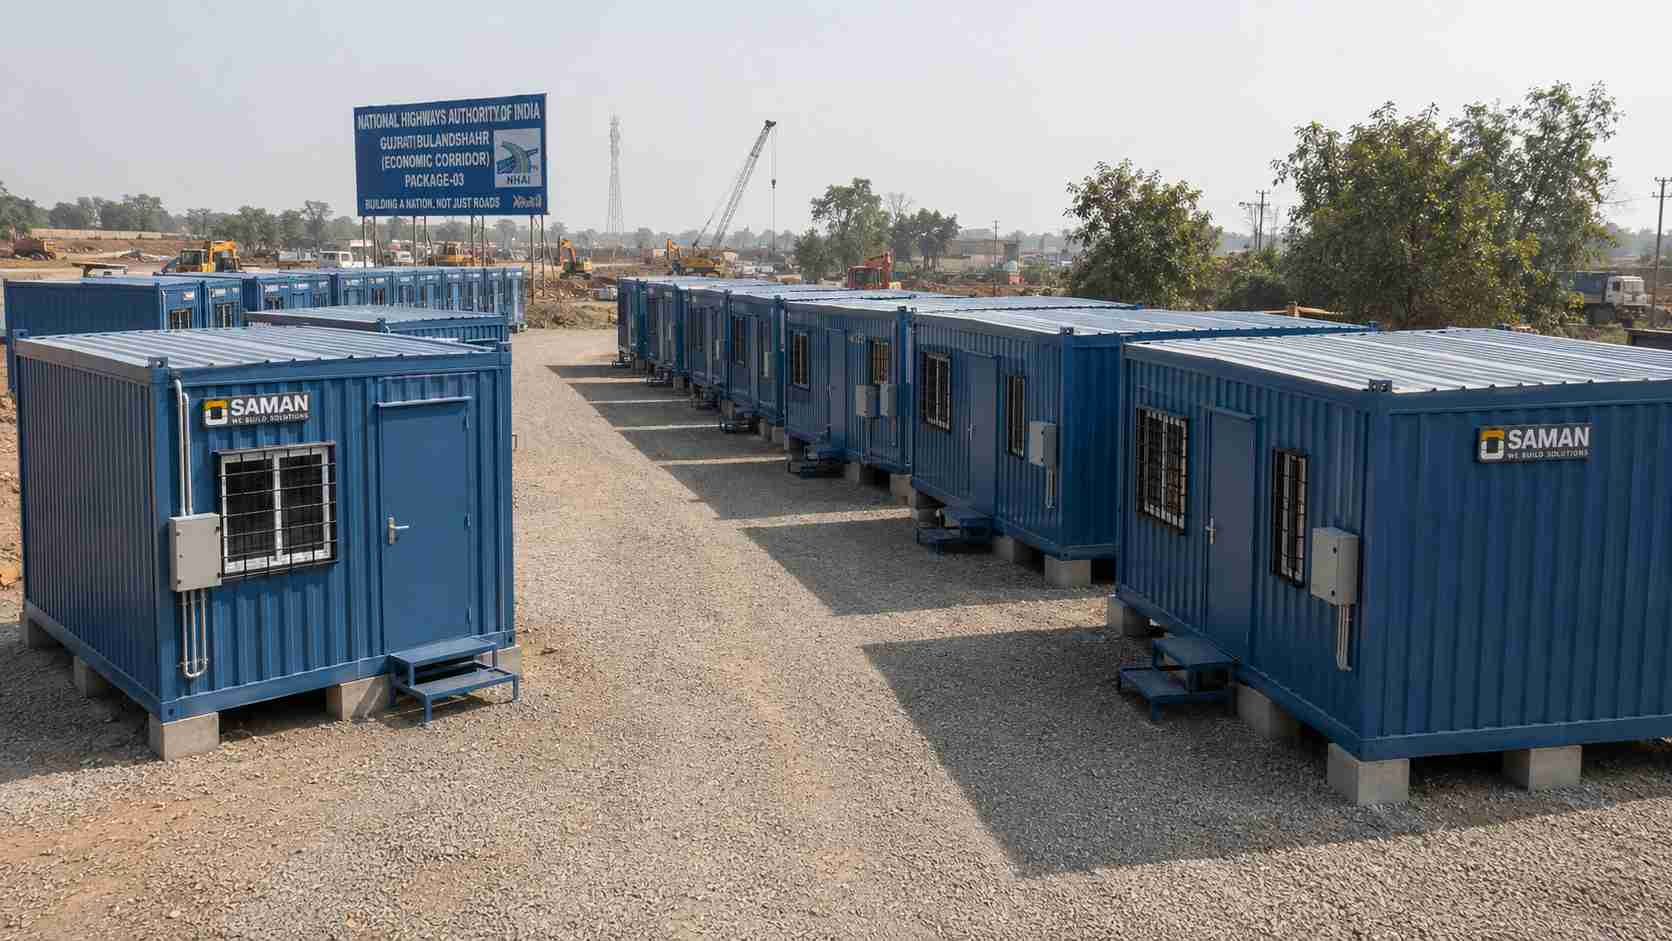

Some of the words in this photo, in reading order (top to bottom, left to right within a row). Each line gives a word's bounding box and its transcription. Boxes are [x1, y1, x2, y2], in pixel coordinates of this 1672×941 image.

[357, 113, 400, 130] NATIONAL
[401, 110, 446, 128] HIGHWAYS
[448, 106, 499, 125] AUTHORITY
[500, 104, 512, 122] OF
[514, 102, 541, 121] INDIA
[382, 153, 433, 171] (ECONOMIC
[434, 151, 490, 168] CORRIDOR)
[405, 173, 465, 188] PACKAGE-03
[365, 198, 398, 210] BUILDING
[399, 199, 405, 209] A
[437, 198, 452, 209] NOT
[453, 197, 473, 209] JUST
[474, 196, 501, 209] ROADS
[231, 394, 309, 416] SAMAN
[1507, 427, 1590, 450] SAMAN
